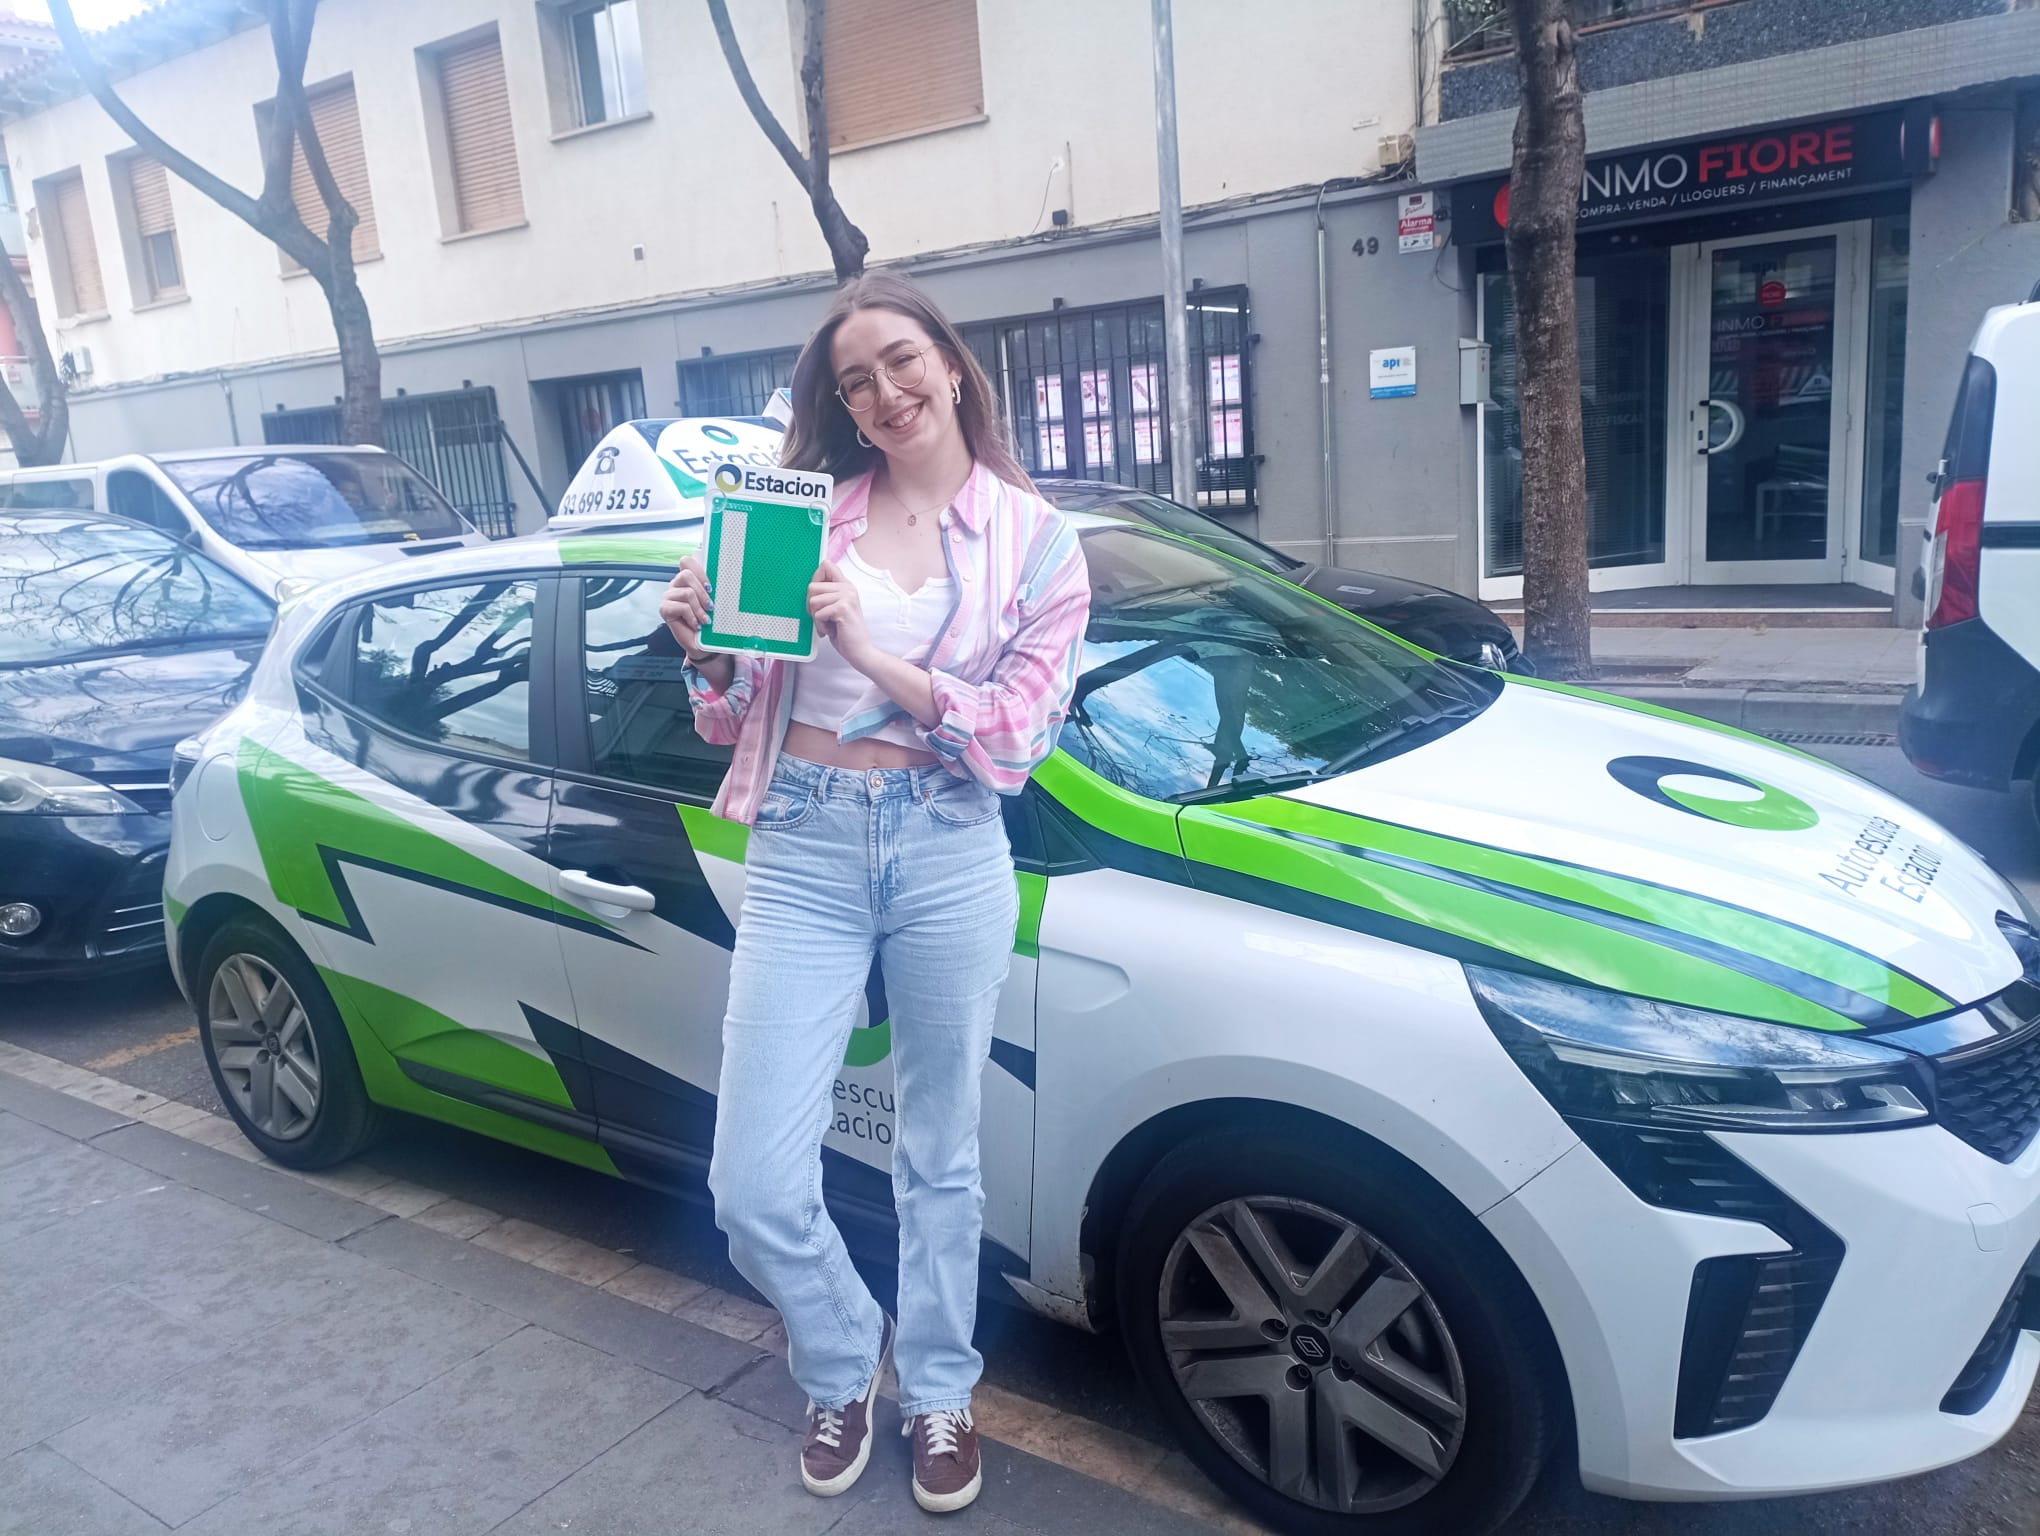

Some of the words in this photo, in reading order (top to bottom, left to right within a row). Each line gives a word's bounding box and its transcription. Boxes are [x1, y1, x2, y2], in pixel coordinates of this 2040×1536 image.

[1582, 153, 1688, 202] NMO
[1699, 124, 1854, 183] FIORE
[1680, 183, 1745, 204] LLOGUERS
[1759, 167, 1853, 191] FINANÇAMENT
[1400, 217, 1432, 230] Alarma
[1351, 236, 1379, 257] 49
[1716, 315, 1765, 332] INMO
[1382, 358, 1400, 370] api
[744, 470, 827, 499] Estacion
[563, 493, 577, 516] 93
[578, 490, 604, 514] 699
[605, 488, 626, 511] 52
[629, 487, 651, 510] 55
[711, 509, 800, 643] L
[832, 1079, 896, 1114] escu
